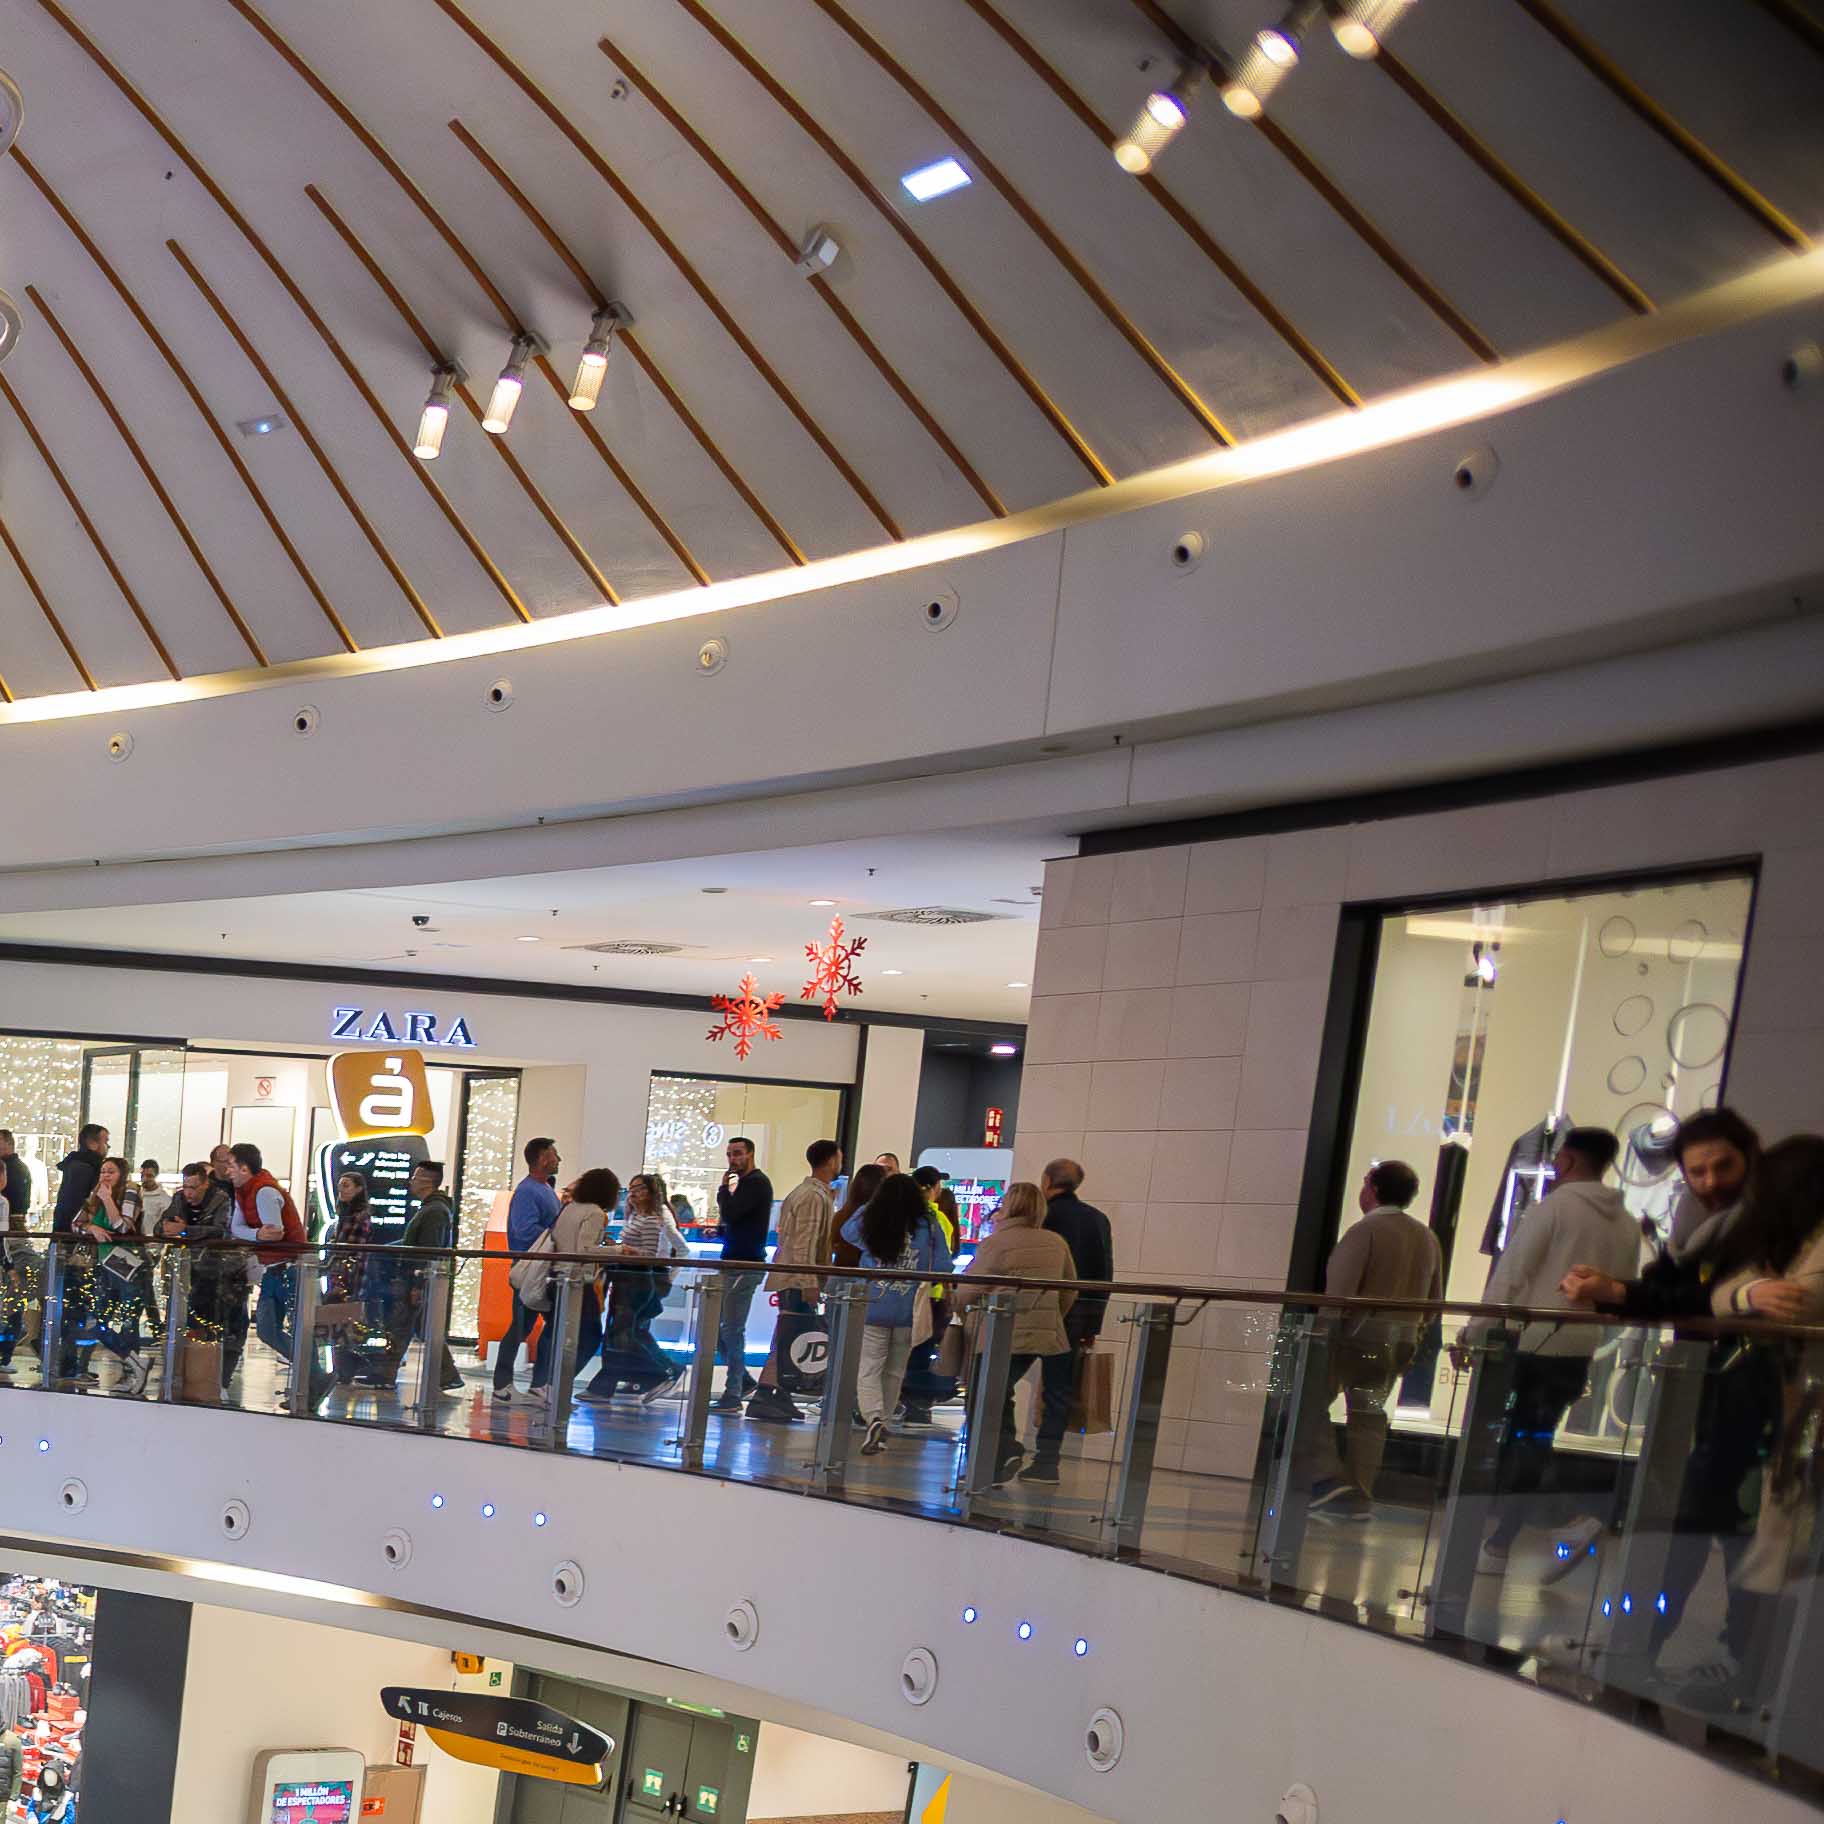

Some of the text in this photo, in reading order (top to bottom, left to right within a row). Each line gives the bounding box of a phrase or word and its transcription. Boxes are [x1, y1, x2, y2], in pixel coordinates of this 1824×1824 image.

[332, 1007, 477, 1048] ZARA
[536, 1719, 564, 1735] Salida
[276, 1795, 346, 1807] DE ESPECTADORES
